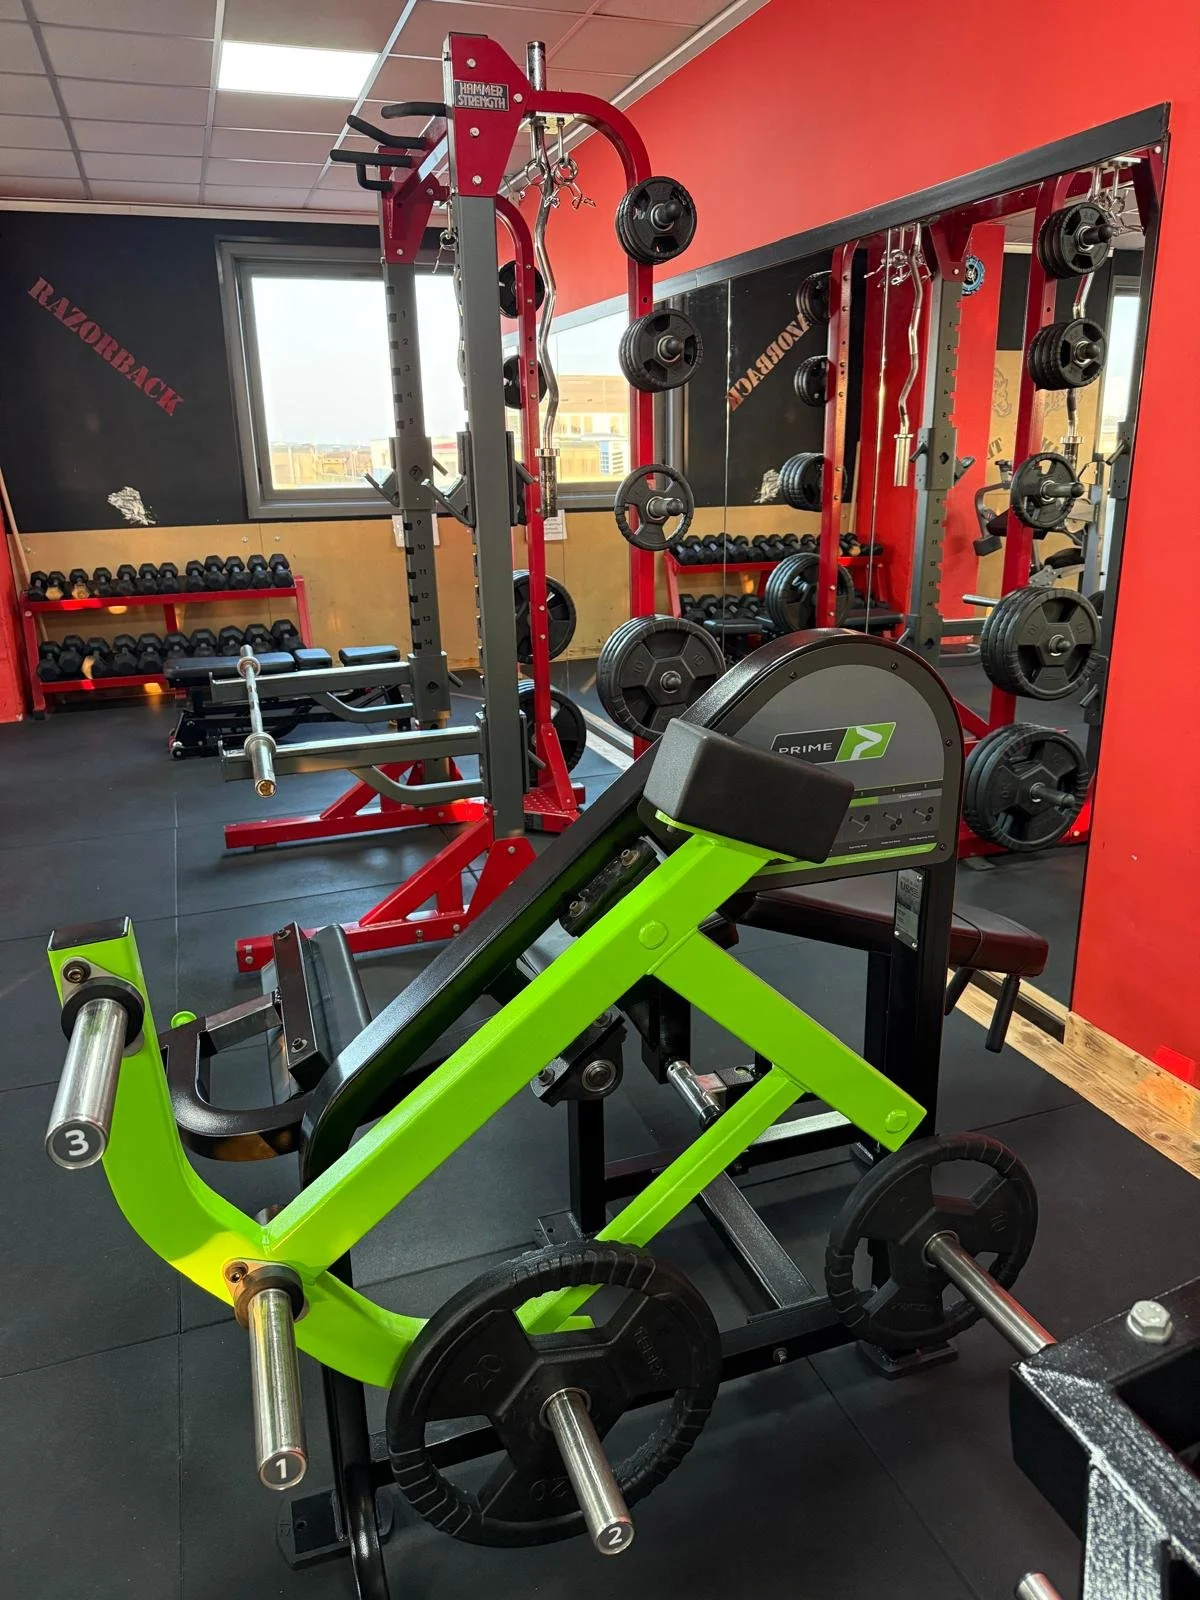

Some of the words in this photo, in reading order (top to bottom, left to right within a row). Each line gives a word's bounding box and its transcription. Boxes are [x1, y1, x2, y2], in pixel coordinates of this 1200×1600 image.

[460, 82, 503, 97] HAMMER
[458, 94, 506, 109] STRENGTH
[27, 276, 184, 416] RAZORBACK
[779, 742, 833, 755] PRIME
[64, 1129, 90, 1156] 3
[275, 1458, 287, 1479] 1
[608, 1526, 622, 1545] 2
